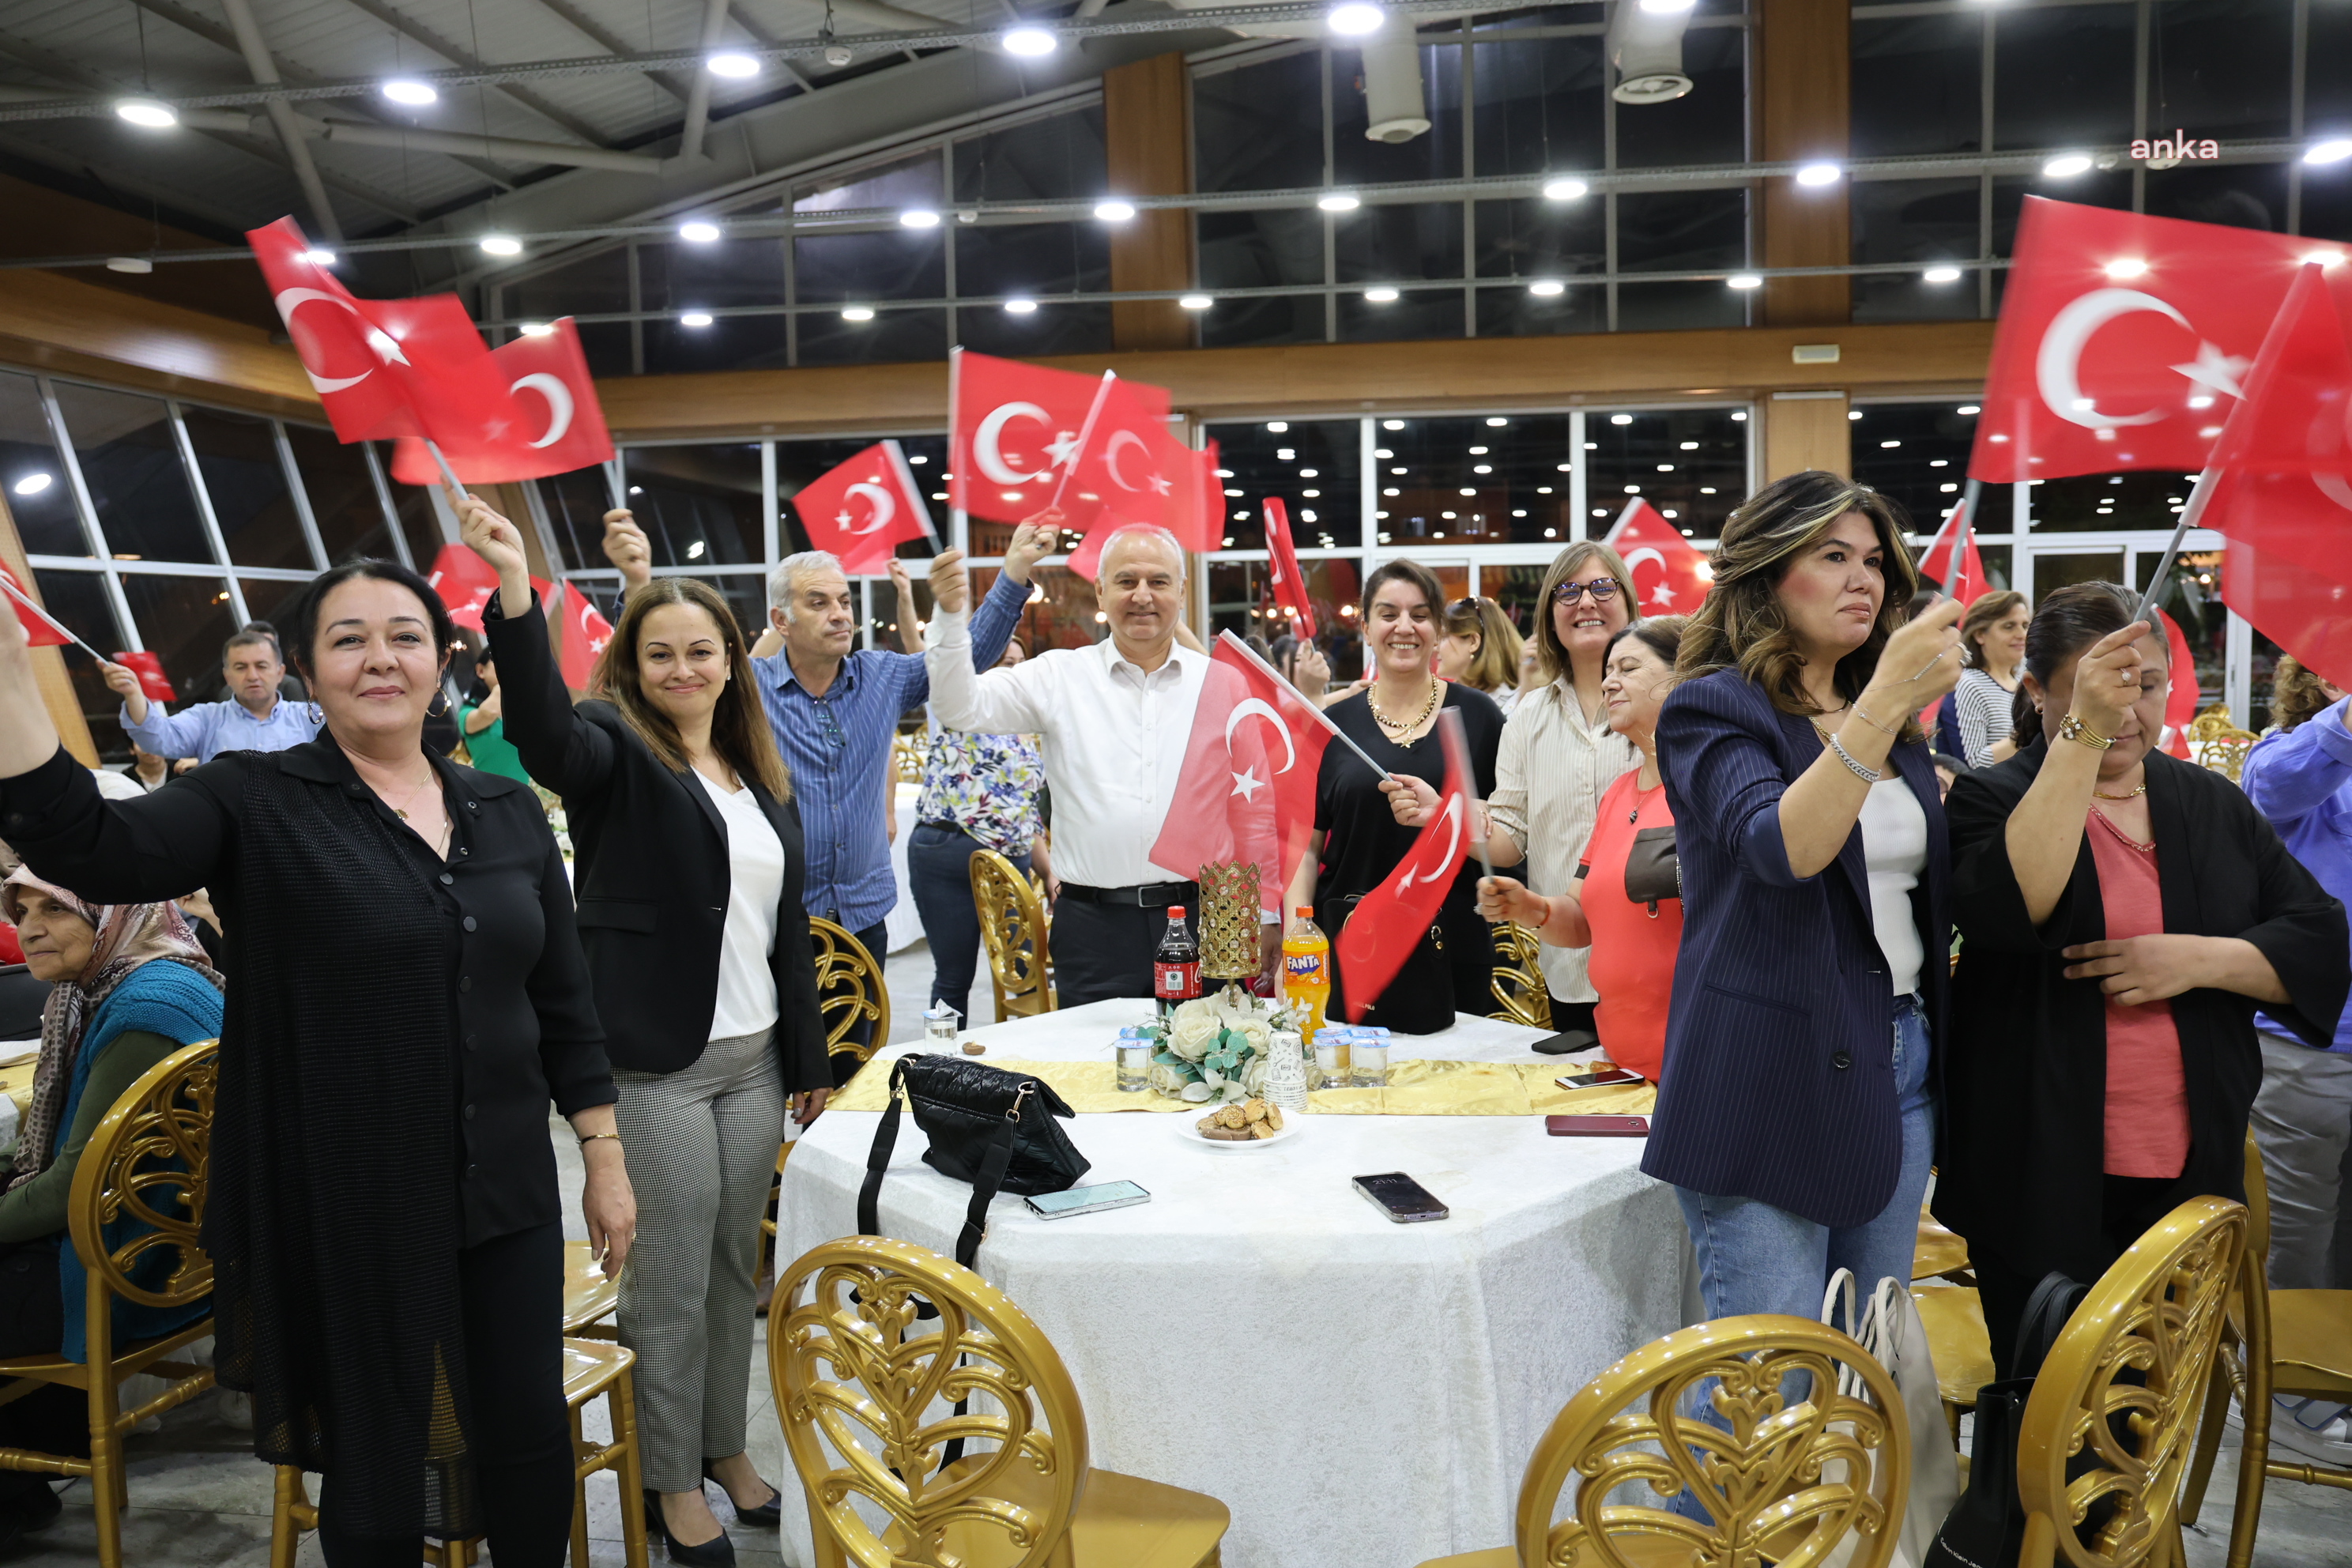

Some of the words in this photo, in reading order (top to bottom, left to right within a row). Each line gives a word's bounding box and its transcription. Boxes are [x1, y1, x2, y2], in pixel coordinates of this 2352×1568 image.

[1286, 955, 1320, 970] FANTA
[1940, 1536, 1953, 1555] Calvin
[1953, 1551, 1968, 1563] Klein
